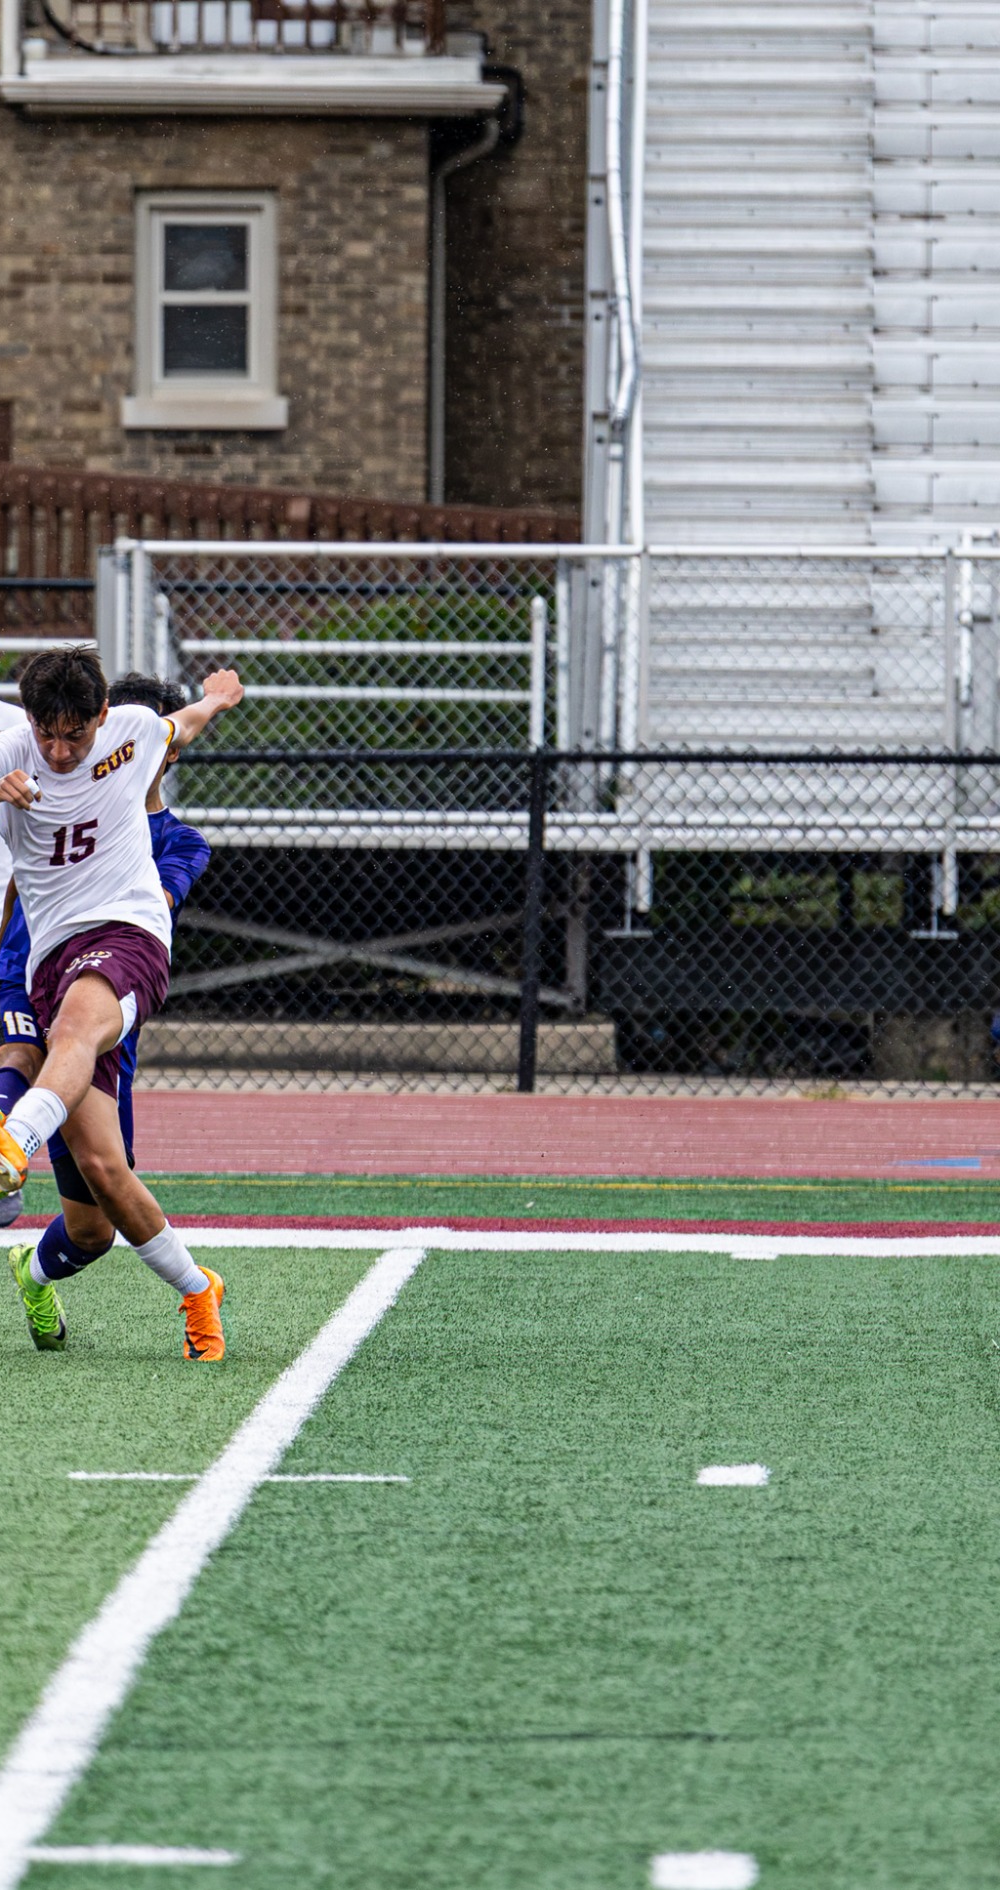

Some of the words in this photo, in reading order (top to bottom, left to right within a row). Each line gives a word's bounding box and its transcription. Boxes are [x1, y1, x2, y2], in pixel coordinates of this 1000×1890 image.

[91, 739, 136, 782] CUC
[49, 818, 98, 866] 15
[3, 1011, 37, 1038] 16
